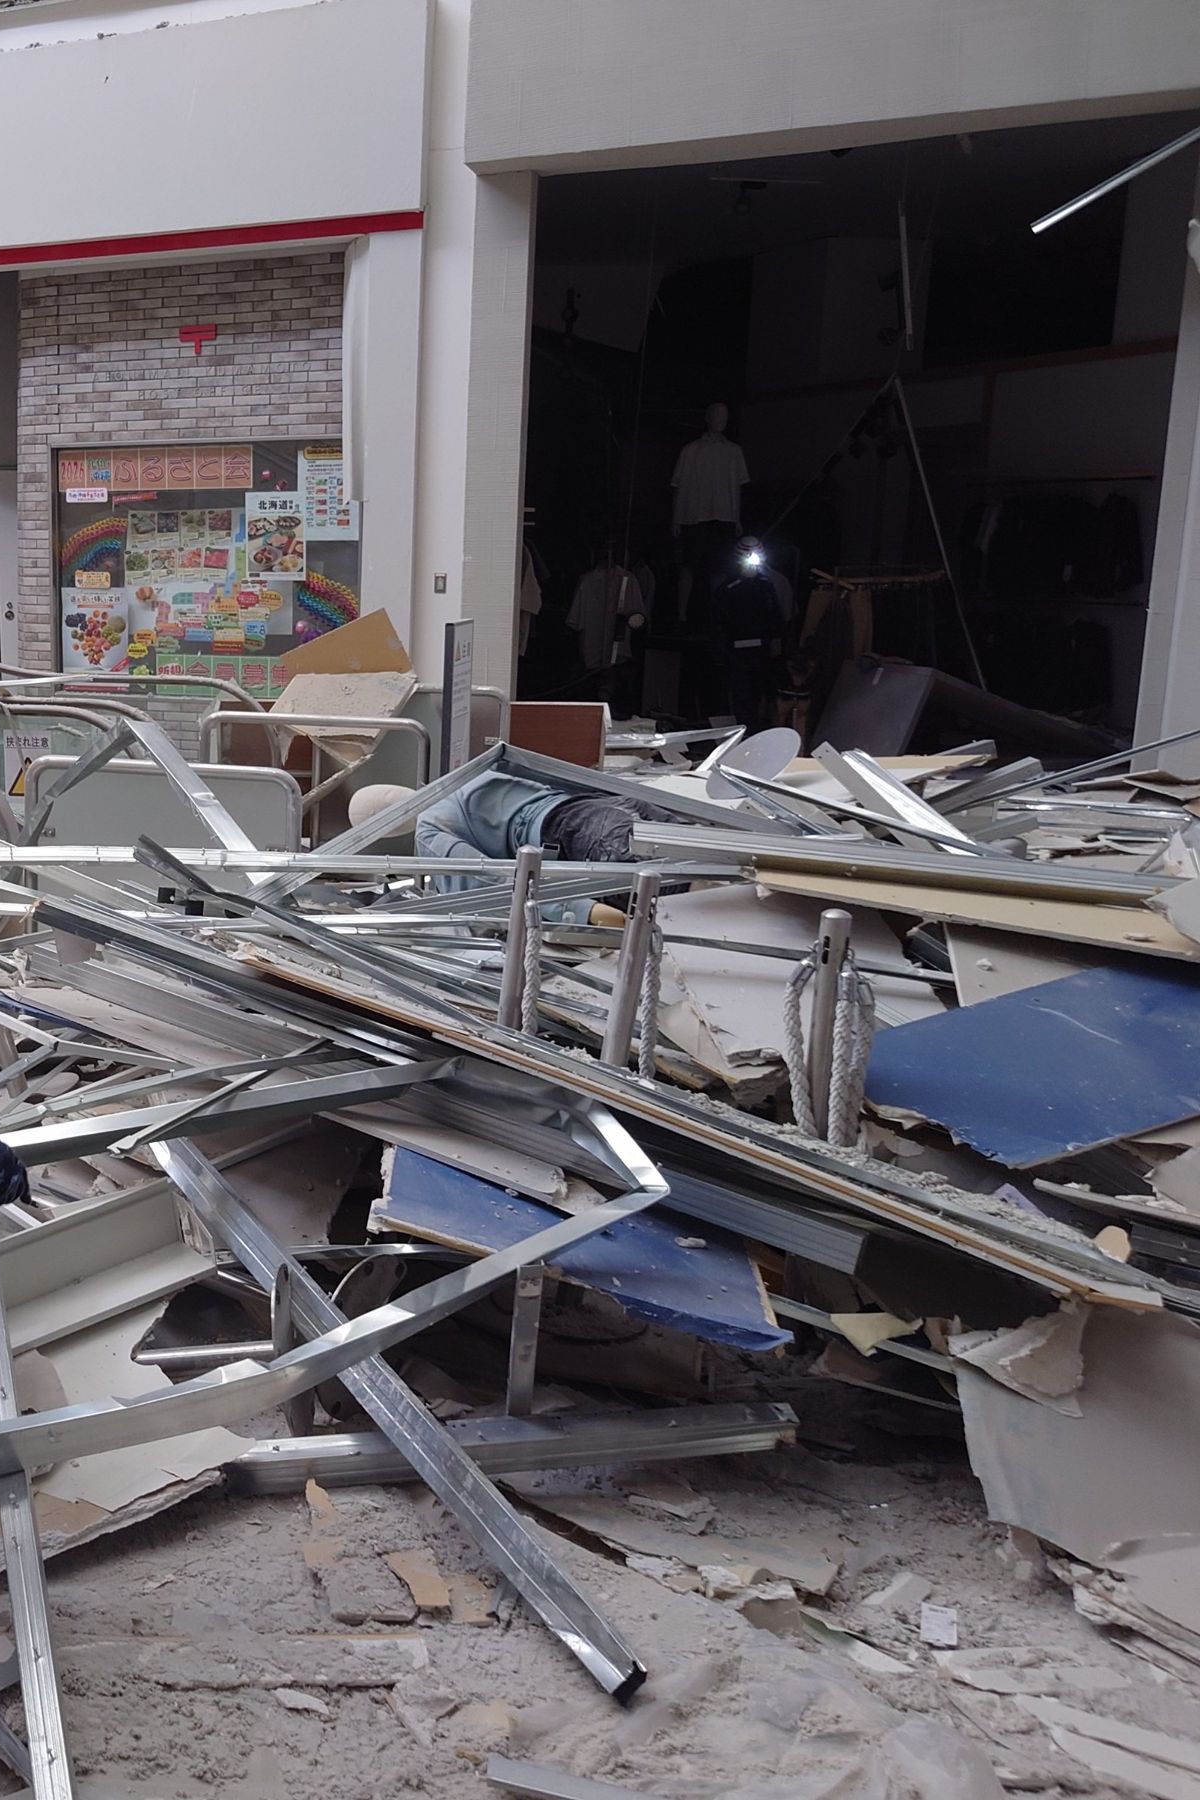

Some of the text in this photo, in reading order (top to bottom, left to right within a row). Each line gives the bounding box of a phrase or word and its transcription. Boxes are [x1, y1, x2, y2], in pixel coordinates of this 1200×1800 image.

[61, 460, 84, 481] 2026
[115, 453, 251, 483] ふるさと会
[258, 499, 289, 511] 北海道
[6, 735, 49, 748] 挟まれ注意
